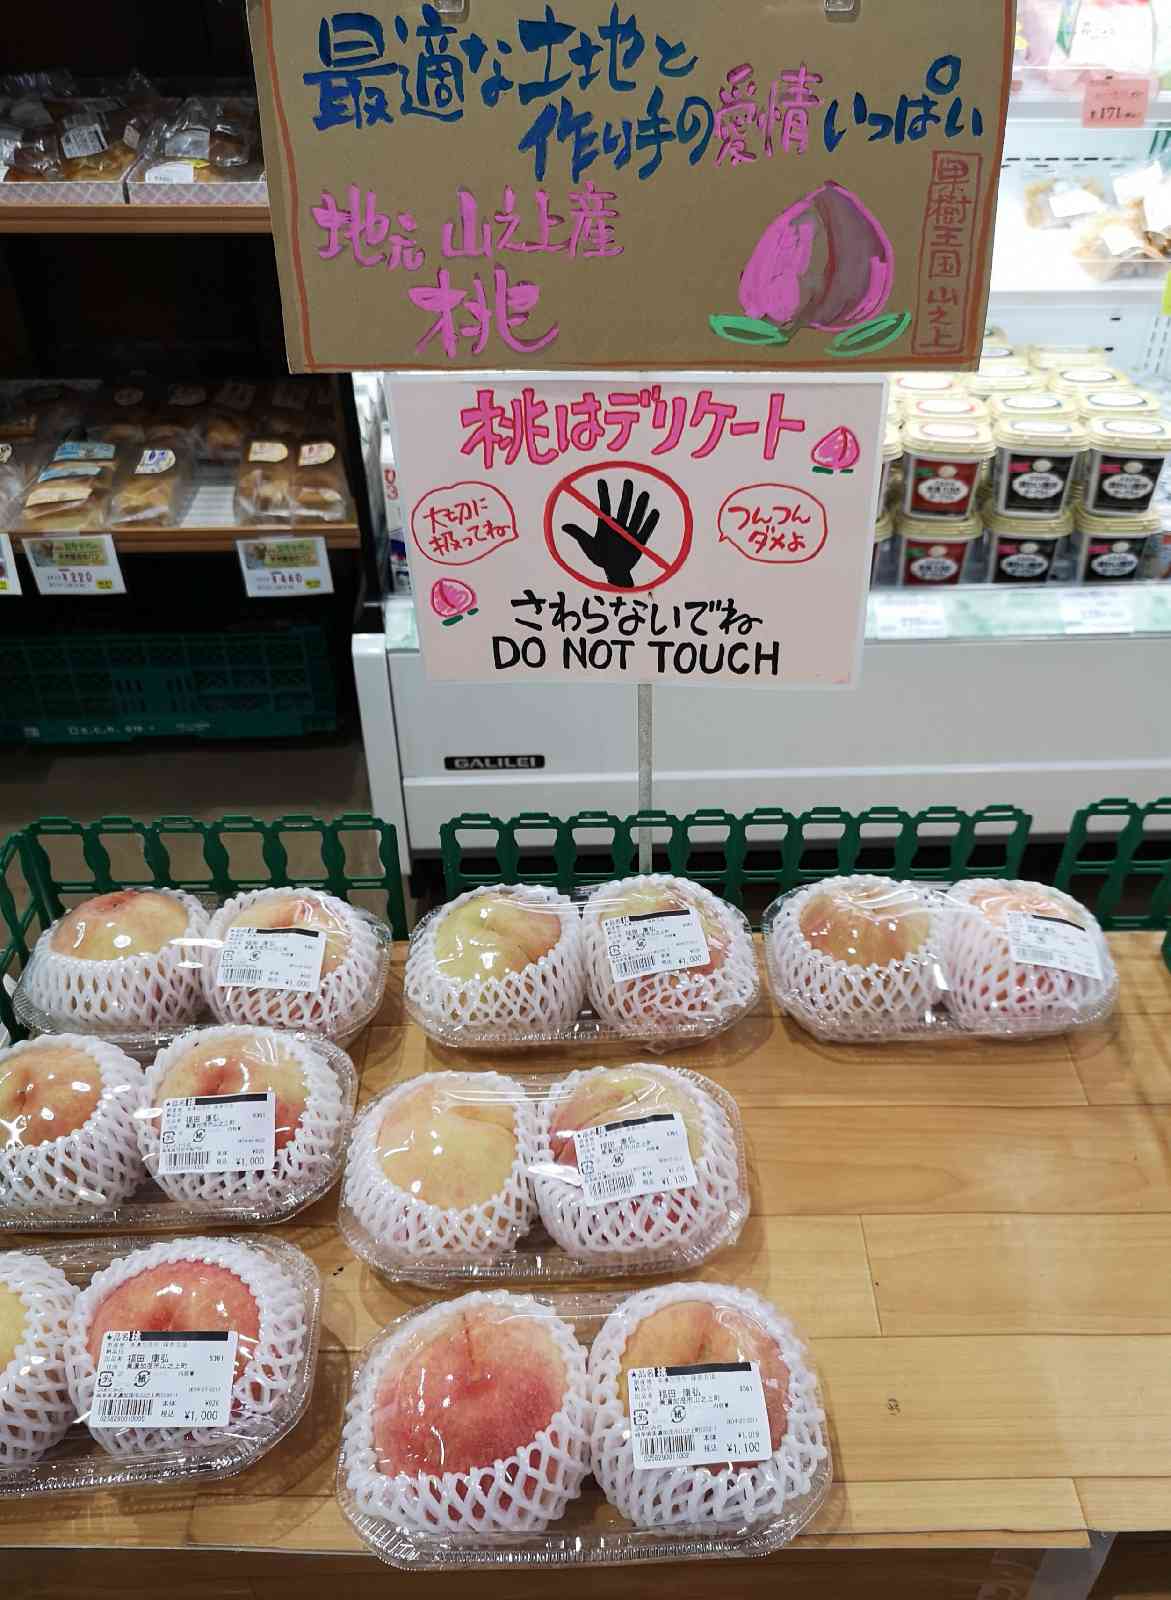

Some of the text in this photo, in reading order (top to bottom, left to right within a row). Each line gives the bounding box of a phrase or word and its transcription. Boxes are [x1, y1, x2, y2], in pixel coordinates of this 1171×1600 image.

[303, 3, 699, 131] 最適な土地と
[518, 54, 984, 185] 作り手の愛情いっぱい
[311, 180, 625, 271] 地元 山之上産
[408, 263, 561, 359] 桃
[460, 385, 806, 469] 桃はデリケート
[423, 497, 489, 535] 大切に
[727, 503, 812, 531] つんつん
[428, 519, 512, 556] 扱ってね
[747, 524, 807, 554] ダメよ
[510, 588, 764, 637] さわらないでね
[491, 635, 780, 676] DO NOT TOUCH
[453, 756, 537, 769] GALILEI
[184, 1409, 219, 1423] ¥1,000
[726, 1441, 760, 1455] ¥1,100
